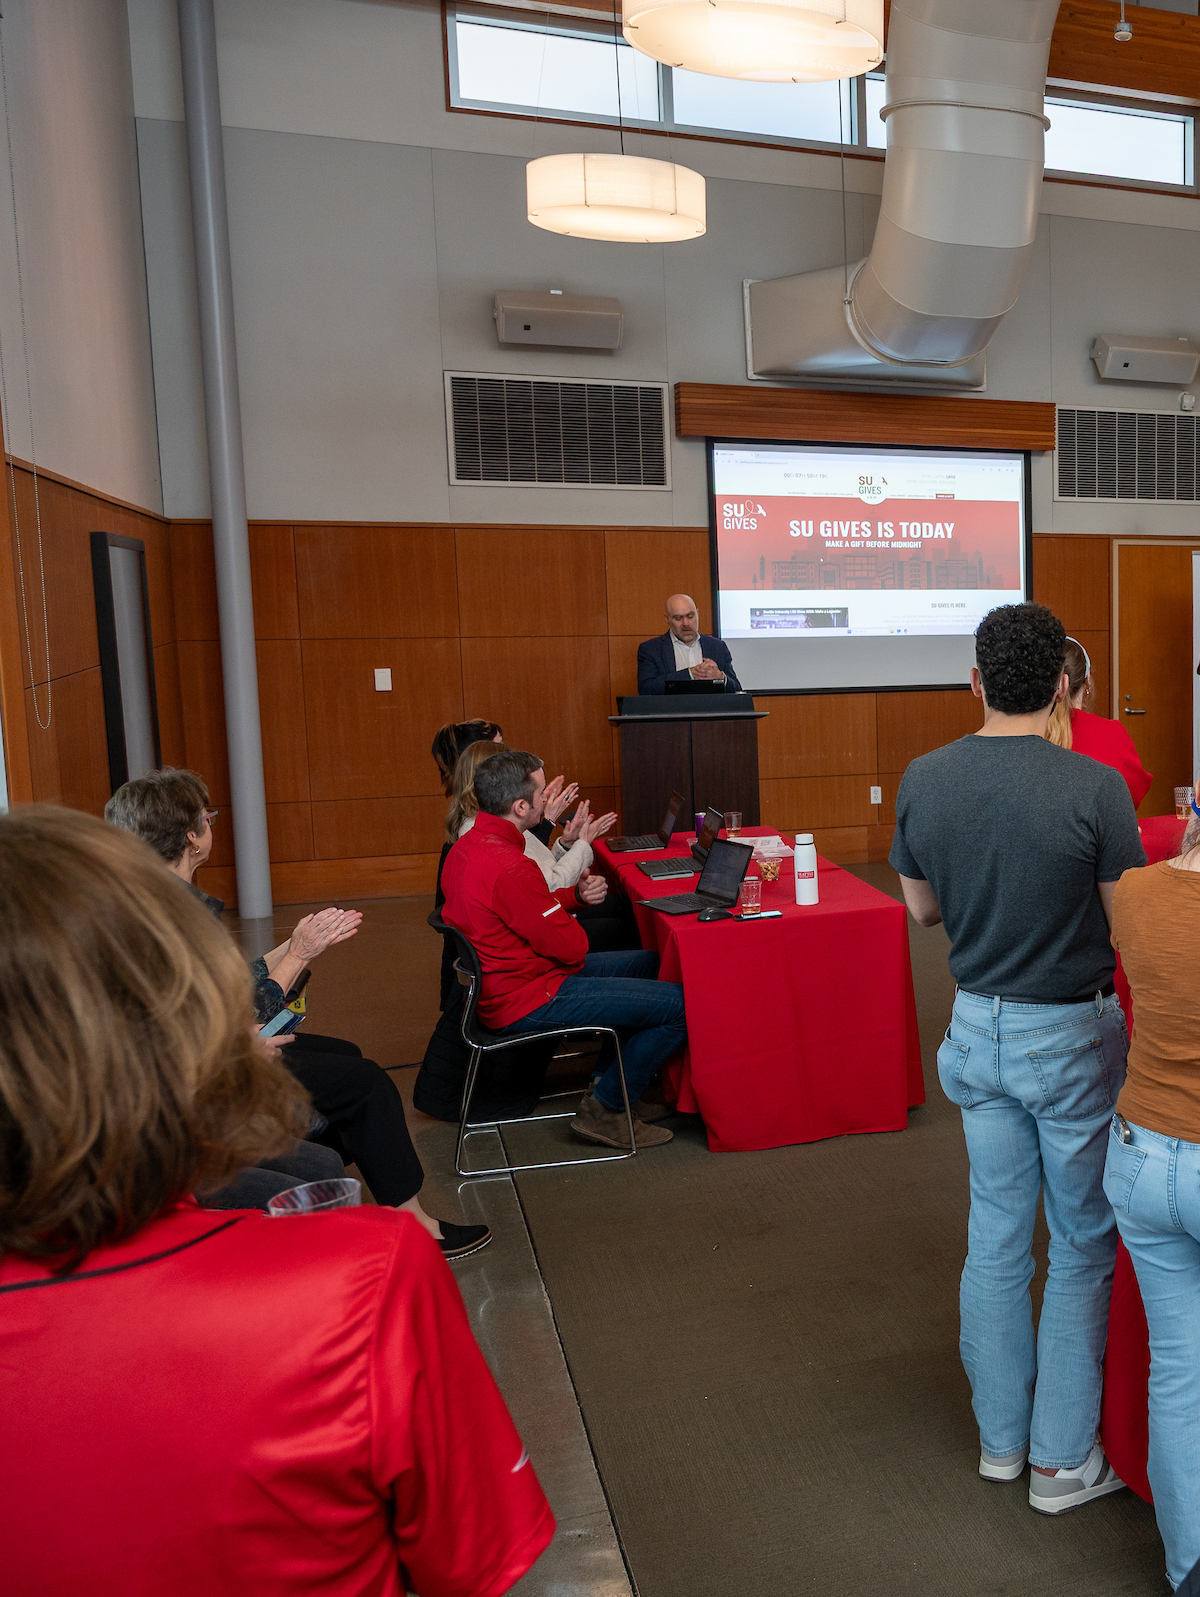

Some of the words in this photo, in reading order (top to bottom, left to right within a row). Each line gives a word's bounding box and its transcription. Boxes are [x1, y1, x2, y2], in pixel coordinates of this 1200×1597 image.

[858, 475, 873, 486] SU
[858, 486, 882, 495] GIVES
[723, 503, 745, 518] SU
[723, 517, 758, 530] GIVES
[789, 520, 814, 537] SU
[819, 520, 872, 538] GIVES
[877, 521, 895, 538] IS
[899, 522, 955, 539] TODAY
[825, 540, 843, 548] MAKE
[844, 540, 850, 548] A
[850, 540, 865, 548] GIFT
[866, 540, 890, 549] BEFORE
[891, 541, 922, 549] MIDNIGHT
